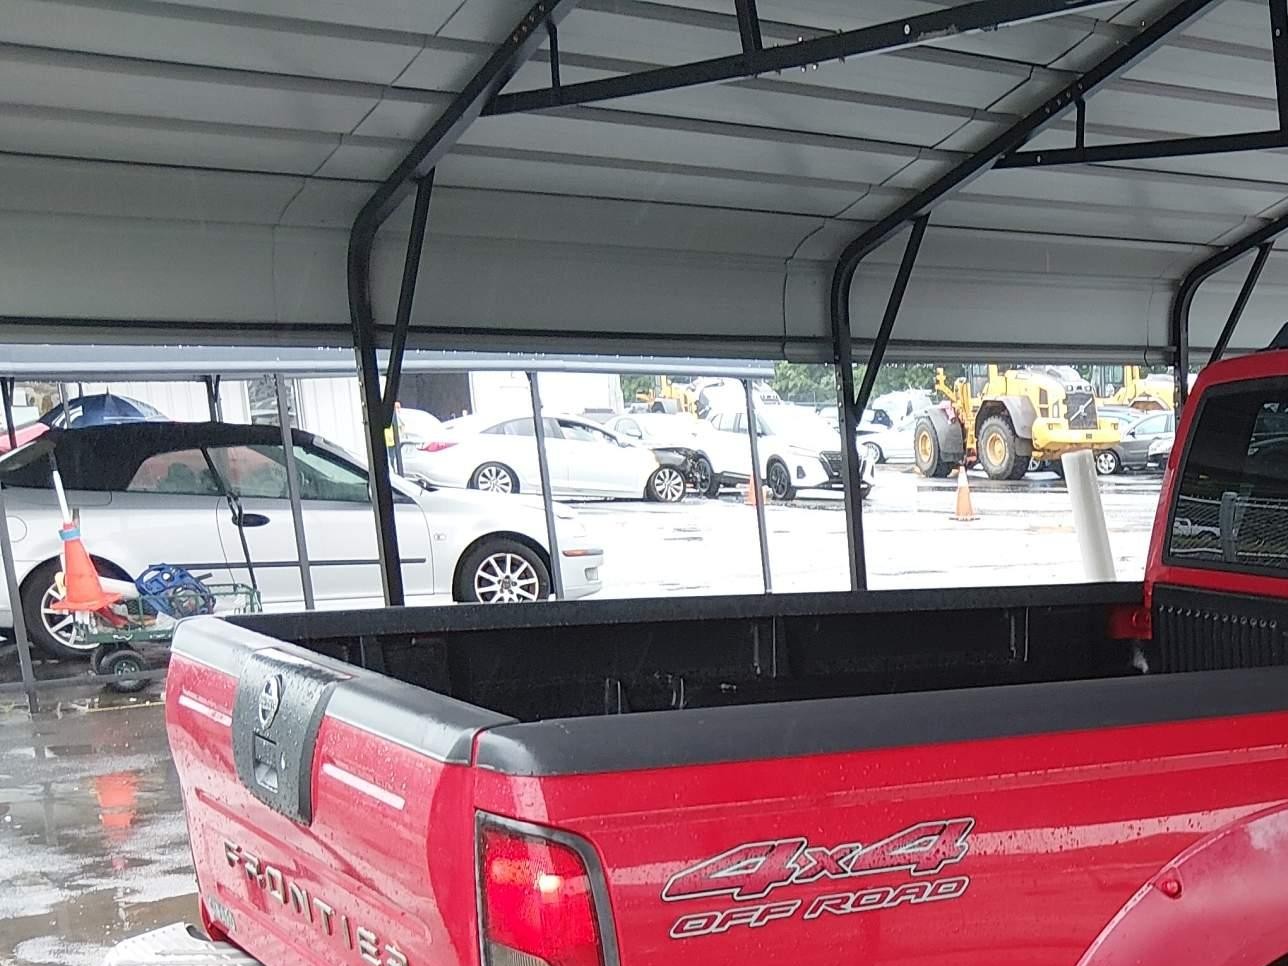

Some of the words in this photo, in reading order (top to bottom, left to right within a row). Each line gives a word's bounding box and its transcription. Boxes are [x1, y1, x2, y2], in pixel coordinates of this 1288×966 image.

[661, 817, 975, 901] 4x4
[669, 899, 802, 939] OFF
[803, 875, 970, 919] ROAD
